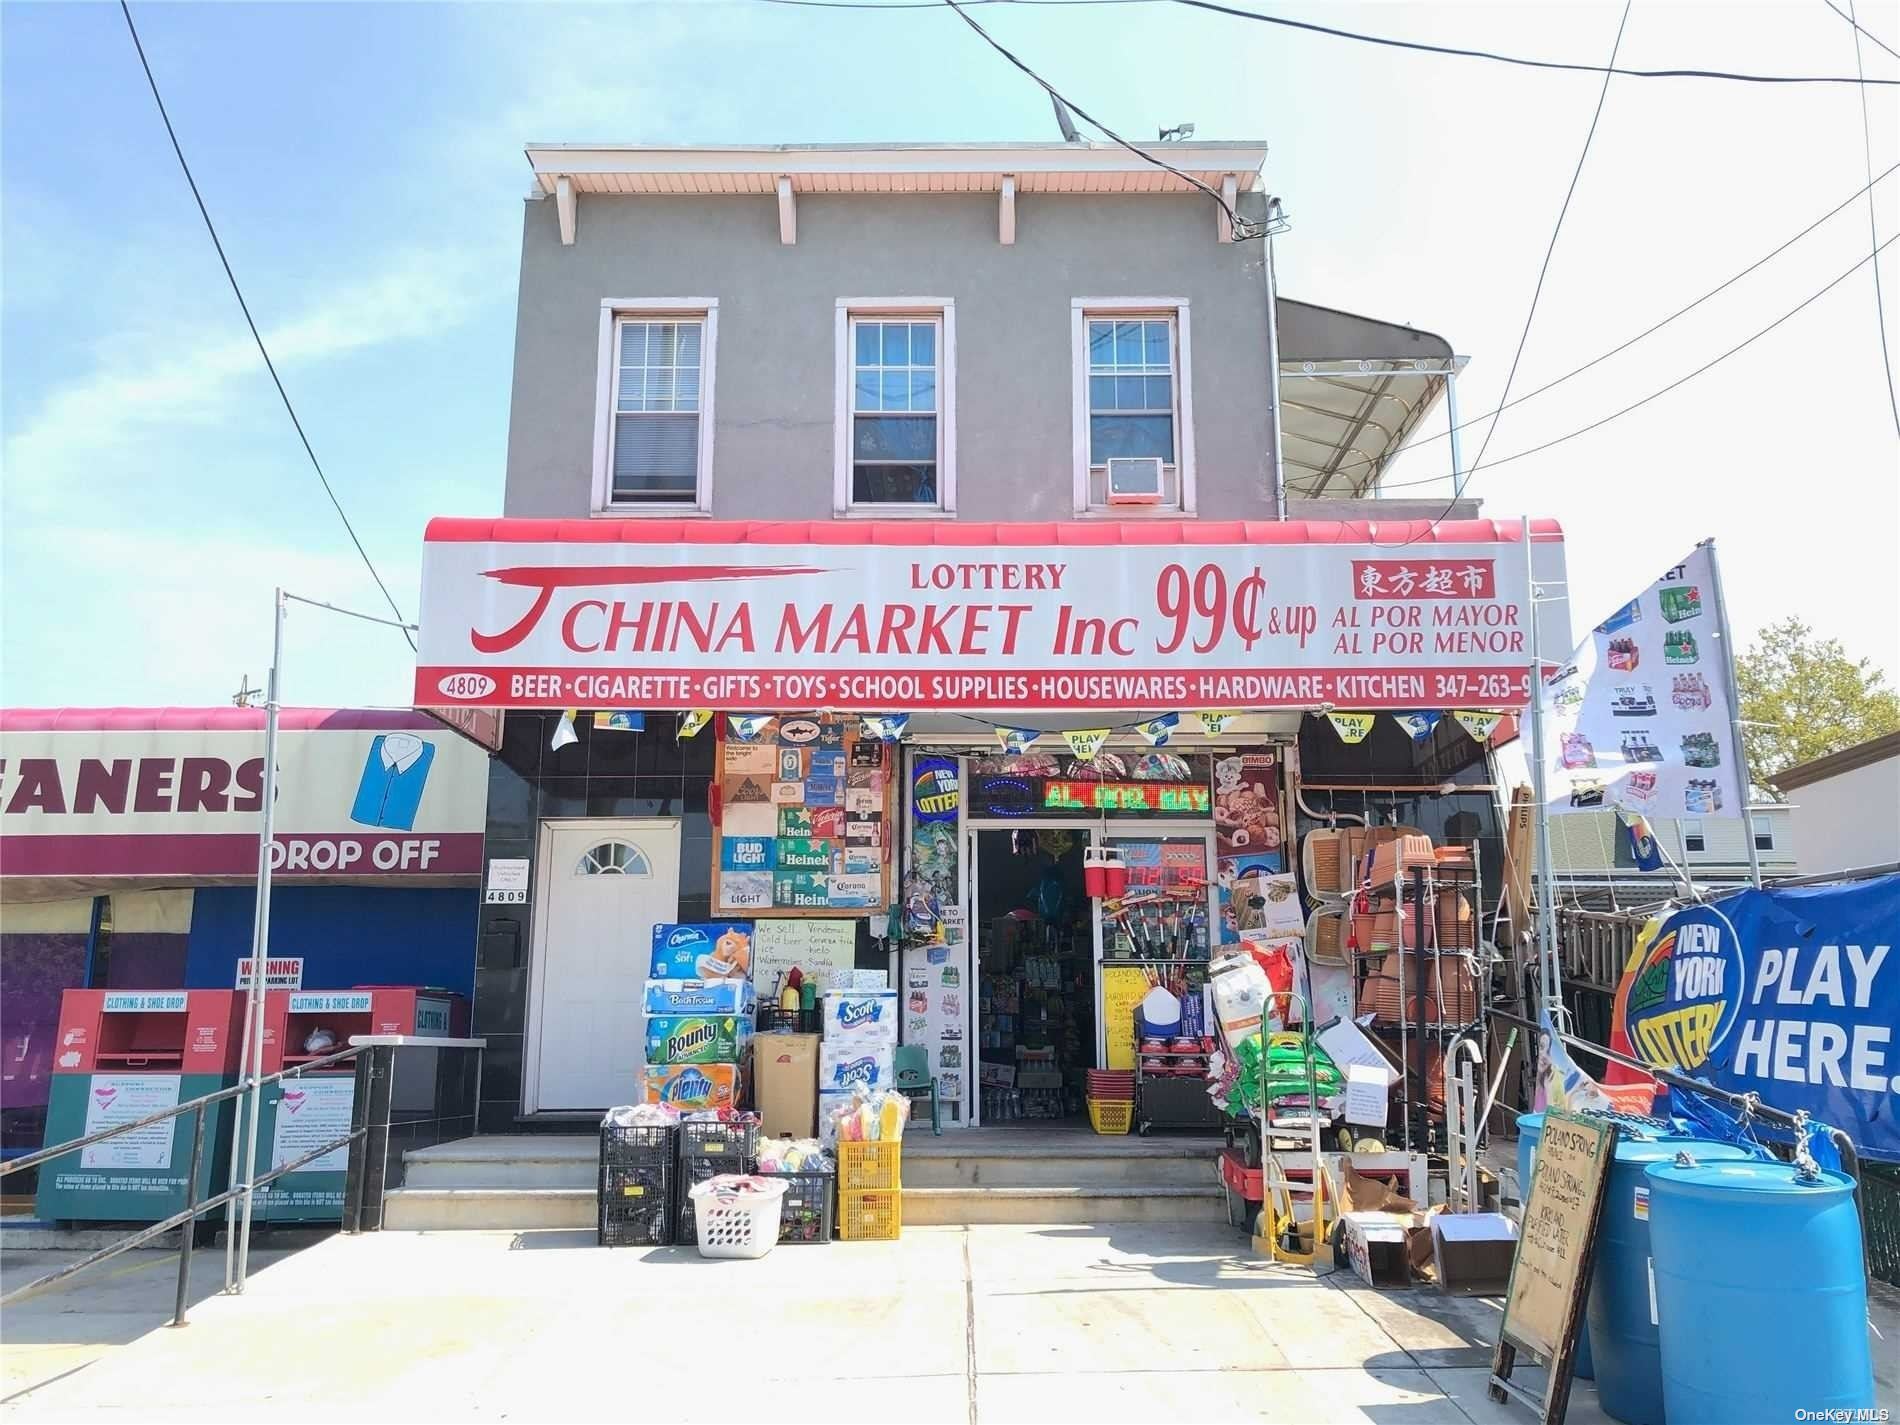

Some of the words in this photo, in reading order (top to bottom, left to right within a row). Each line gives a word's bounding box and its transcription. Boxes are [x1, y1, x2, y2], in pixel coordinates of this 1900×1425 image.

[911, 563, 1067, 590] LOTTERY
[1360, 565, 1488, 598] 東方超市
[561, 599, 756, 654] CHINA
[774, 602, 1033, 656] MARKET
[1053, 604, 1139, 656] Inc
[1155, 563, 1267, 655] 99¢
[1331, 605, 1362, 628] AL
[1371, 605, 1422, 628] POR
[1431, 603, 1519, 627] MAYOR
[1333, 632, 1363, 655] AL
[1373, 631, 1424, 654] POR
[1434, 631, 1525, 654] MENOR
[446, 675, 488, 696] 4809
[574, 674, 691, 698] CIGARETTE
[703, 674, 761, 698] GIFTS
[772, 674, 825, 698] TOYS
[839, 674, 925, 699] SCHOOL
[932, 674, 1029, 699] SUPPLIES
[1041, 675, 1187, 699] HOUSEWARES
[1199, 675, 1324, 699] HARDWARE
[1336, 675, 1425, 698] KITCHEN
[1071, 735, 1101, 744] PLAY
[1241, 755, 1273, 766] BIMBO
[0, 757, 280, 814] ANERS
[935, 770, 954, 779] NEW
[1046, 785, 1083, 808] AL
[268, 840, 362, 870] DROP
[372, 840, 441, 870] OFF
[733, 853, 765, 864] LIGHT
[736, 843, 763, 853] BUD
[487, 891, 525, 902] 4809
[731, 895, 760, 904] LIGHT
[1677, 924, 1720, 954] NEW
[241, 960, 300, 975] WNING
[675, 954, 694, 964] Soft
[288, 977, 299, 985] LOT
[1674, 956, 1727, 1001] YORK
[1752, 944, 1891, 1008] PLAY
[106, 997, 139, 1009] CLOTHING
[147, 997, 165, 1009] SHOE
[166, 997, 184, 1009] DROP
[291, 997, 324, 1009] CLOTHING
[325, 997, 330, 1009] &
[332, 997, 350, 1009] SHOE
[351, 997, 369, 1009] DROP
[844, 998, 877, 1022] Scott
[667, 1023, 718, 1060] Bounty
[1631, 1000, 1727, 1071] LOTTERY
[841, 1063, 872, 1087] Scott
[1545, 1124, 1570, 1150] POLAND
[1570, 1131, 1595, 1158] SPRING
